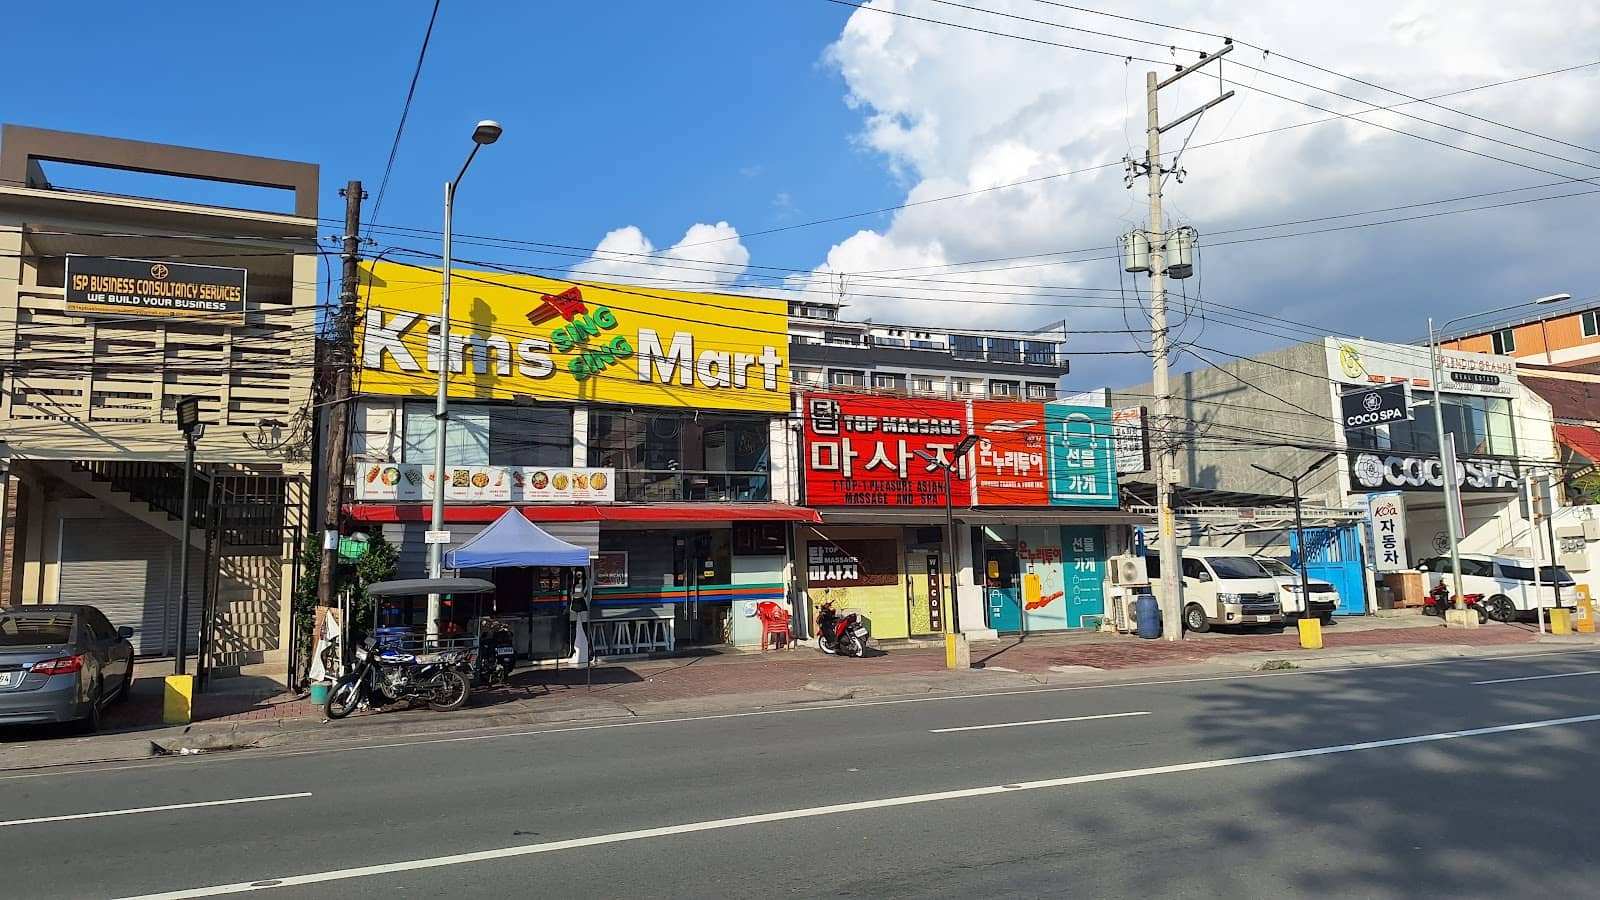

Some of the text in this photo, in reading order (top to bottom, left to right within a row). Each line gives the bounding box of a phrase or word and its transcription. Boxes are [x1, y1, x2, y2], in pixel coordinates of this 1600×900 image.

[91, 276, 135, 294] BUSINESS
[136, 279, 198, 299] CONSULTANCY
[200, 284, 241, 302] SERVICES
[87, 293, 226, 310] WE BUILD YOUR BUSINESS
[551, 306, 618, 351] SING
[363, 307, 782, 391] Kims Mart
[568, 335, 633, 380] SING
[1454, 373, 1471, 381] REAL
[843, 415, 961, 435] TOP MASSAGE
[1347, 407, 1402, 426] COCO SPA
[811, 437, 967, 480] 마사지
[980, 438, 1043, 477] 온누리투어
[1067, 448, 1095, 468] 선물
[1466, 458, 1519, 488] SPA
[870, 480, 912, 492] PLEASURE
[1068, 475, 1096, 494] 가게
[845, 493, 938, 505] MASSAGE AND SPA
[1072, 537, 1094, 552] 선물
[1380, 518, 1399, 565] 자동차
[809, 564, 859, 581] 마사지
[1073, 557, 1096, 573] 가게
[929, 558, 938, 628] WELCOME
